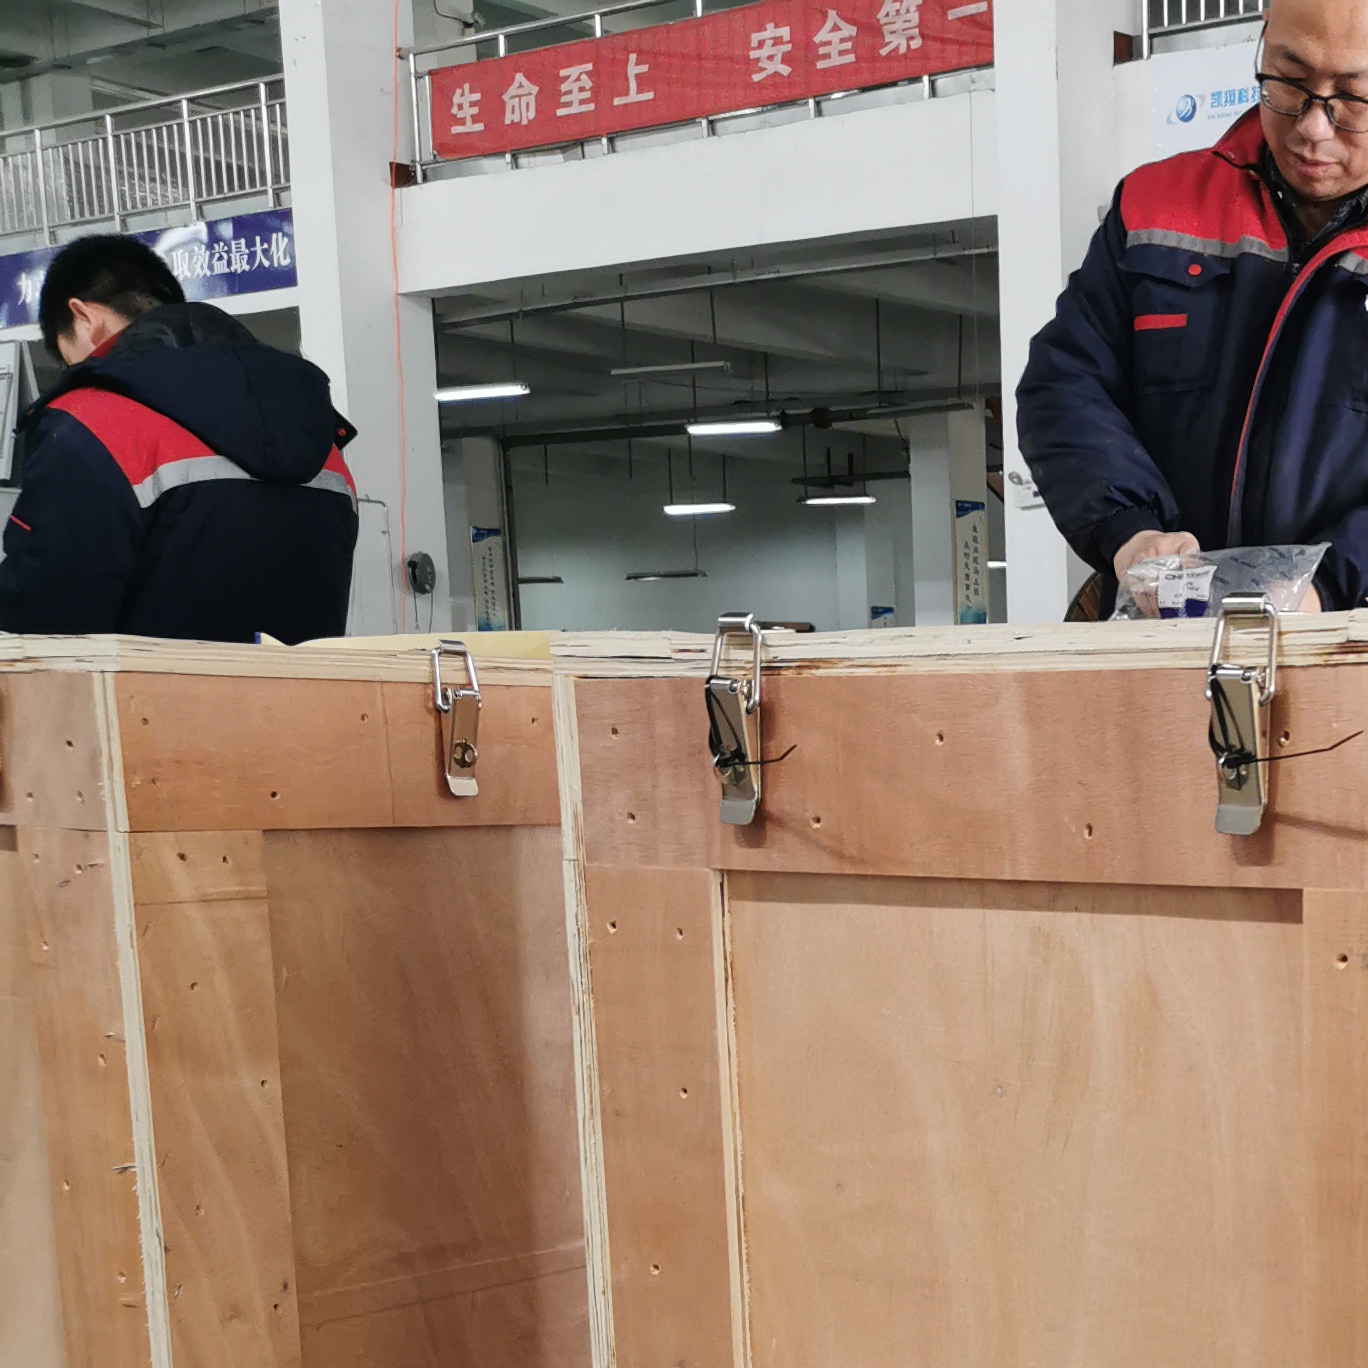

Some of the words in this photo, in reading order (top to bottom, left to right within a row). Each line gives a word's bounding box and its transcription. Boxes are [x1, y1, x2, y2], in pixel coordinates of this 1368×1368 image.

[450, 52, 654, 134] 生命至上
[749, 0, 988, 82] 安全第一
